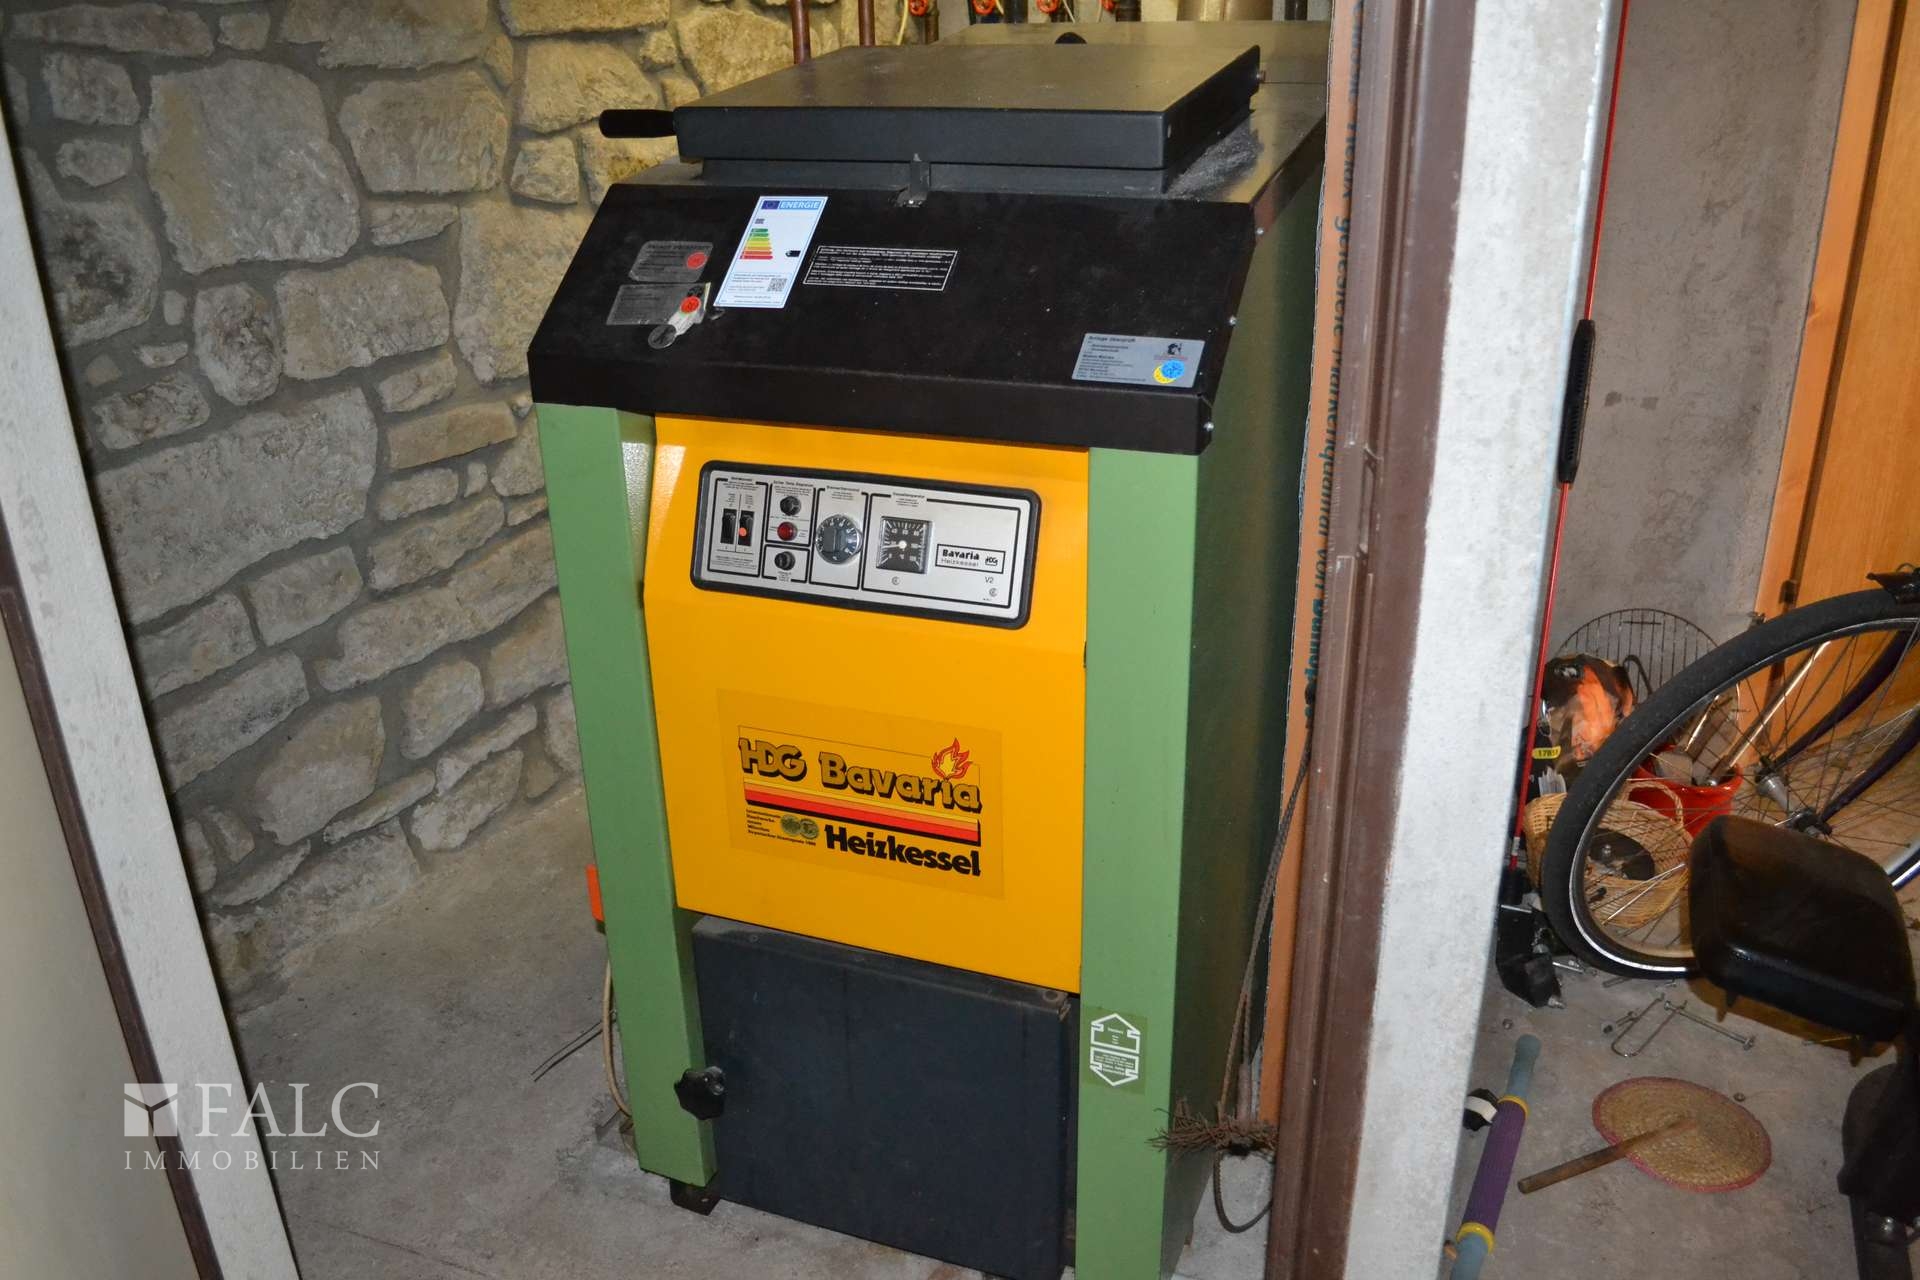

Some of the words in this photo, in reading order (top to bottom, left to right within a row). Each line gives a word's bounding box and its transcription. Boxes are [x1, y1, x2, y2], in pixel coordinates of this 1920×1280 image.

[780, 201, 820, 209] ENERGIE
[942, 549, 980, 561] Bavaria
[941, 559, 979, 567] Heizkessel
[738, 736, 807, 782] HDG
[819, 751, 983, 814] Bavaria
[825, 824, 981, 877] Heizkessel
